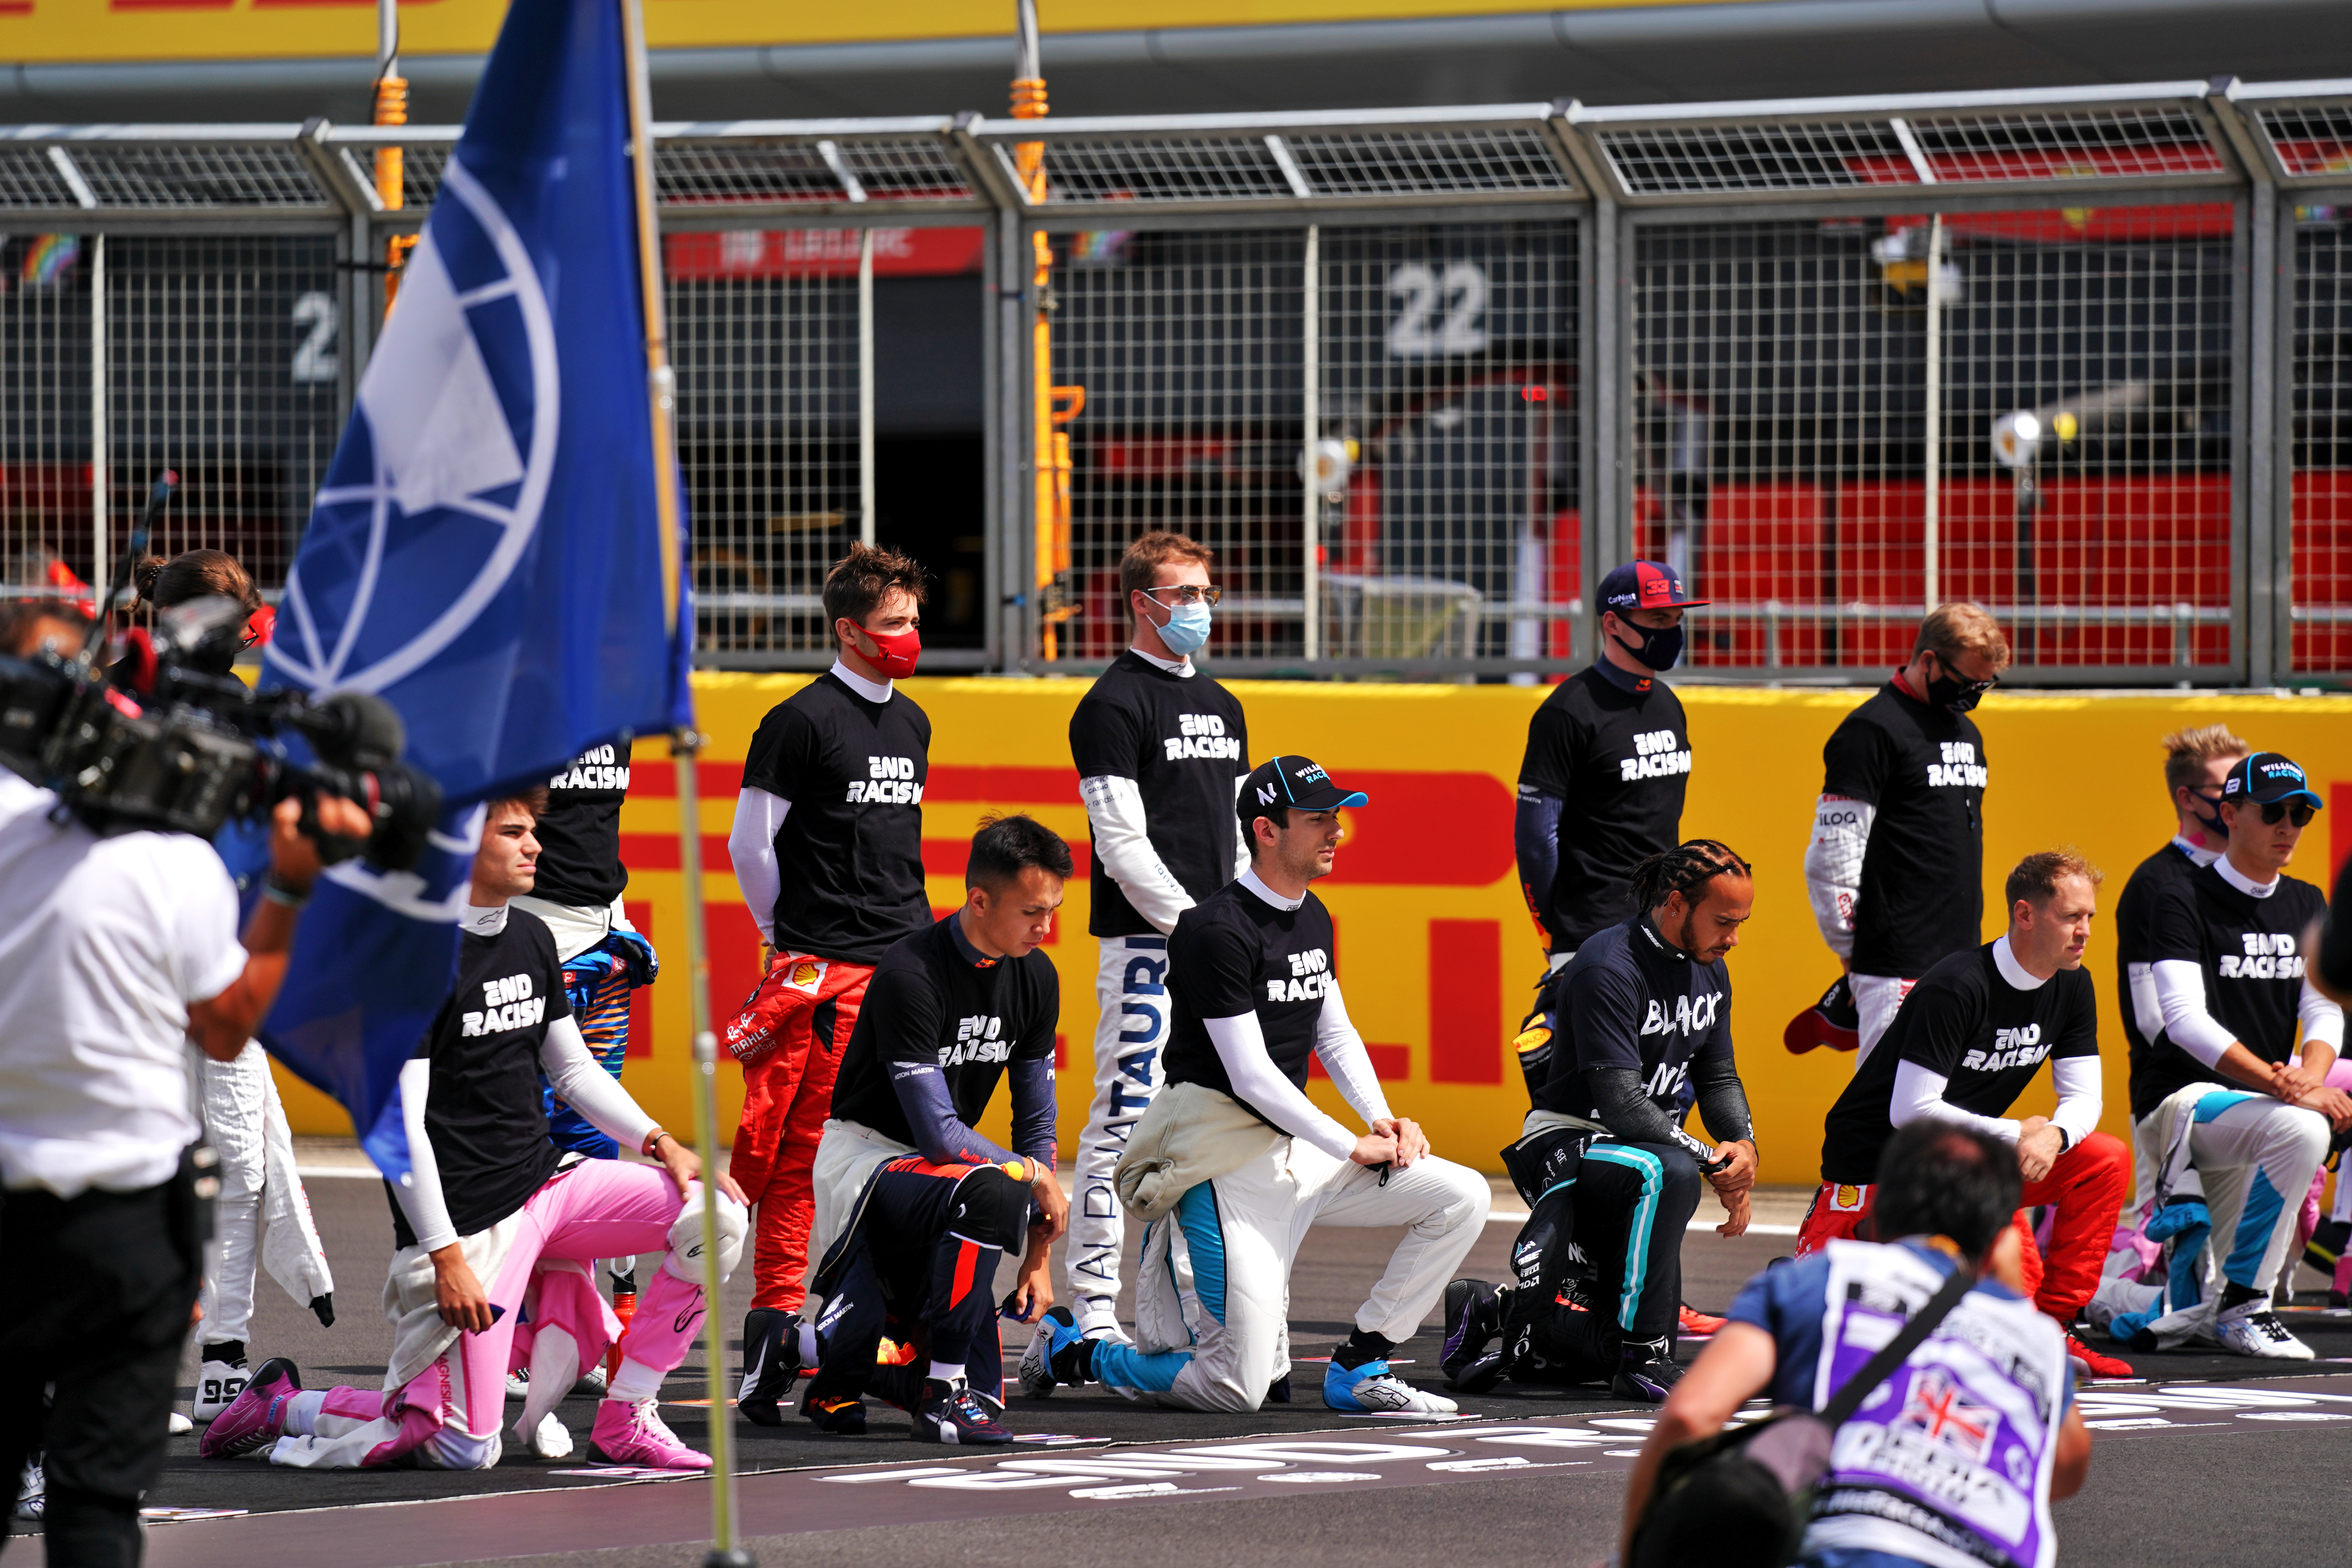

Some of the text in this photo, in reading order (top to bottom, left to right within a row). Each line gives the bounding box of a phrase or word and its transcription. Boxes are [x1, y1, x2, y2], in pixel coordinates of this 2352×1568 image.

[1390, 262, 1488, 356] 22
[1646, 579, 1669, 595] 33
[1179, 714, 1225, 736] END
[1633, 730, 1677, 755] END
[1940, 742, 1975, 764] END
[869, 756, 914, 780] END
[1621, 750, 1691, 781] RACISM
[1088, 784, 1109, 794] CASIO
[1641, 924, 1664, 949] BOSE
[2242, 932, 2296, 956] END
[1288, 948, 1327, 976] END
[483, 973, 533, 1007] END
[957, 1014, 1001, 1041] END
[1640, 991, 1722, 1037] BLACK
[729, 1027, 769, 1055] MAHLE
[1995, 1023, 2040, 1050] END
[911, 1066, 935, 1076] MARTIN
[816, 1301, 855, 1332] STON MARTIN
[438, 1352, 454, 1418] AGNESIUM
[817, 1442, 1454, 1490] END
